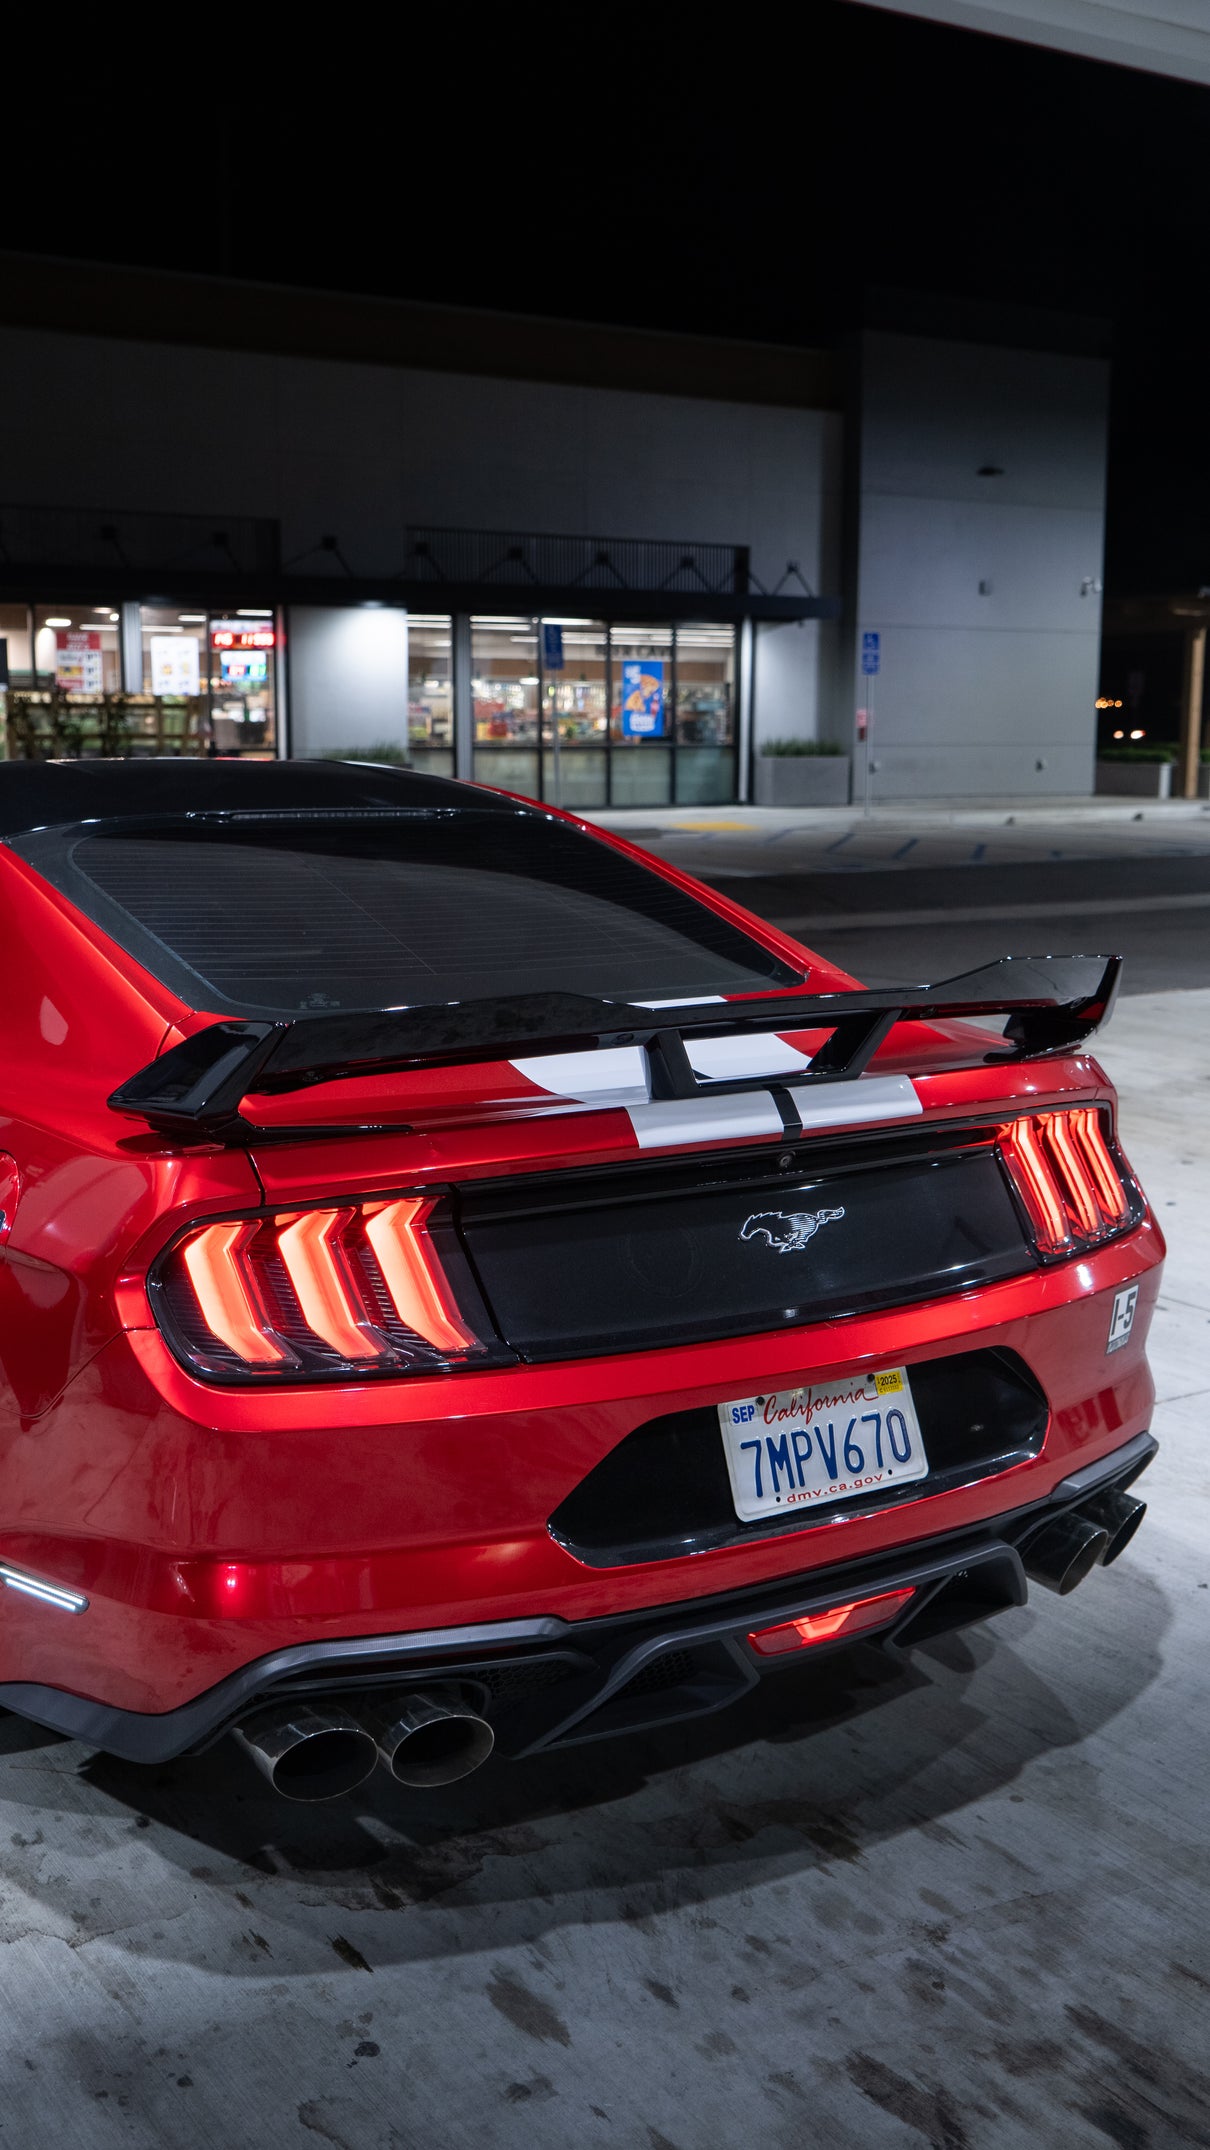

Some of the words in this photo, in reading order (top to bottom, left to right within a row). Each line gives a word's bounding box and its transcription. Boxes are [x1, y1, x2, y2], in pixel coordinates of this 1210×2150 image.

[1111, 1291, 1137, 1336] I-5
[880, 1374, 898, 1386] 2025
[731, 1404, 755, 1425] SEP
[763, 1382, 879, 1425] California
[740, 1407, 912, 1498] 7MPV670
[786, 1473, 883, 1504] dmv.ca.gov
